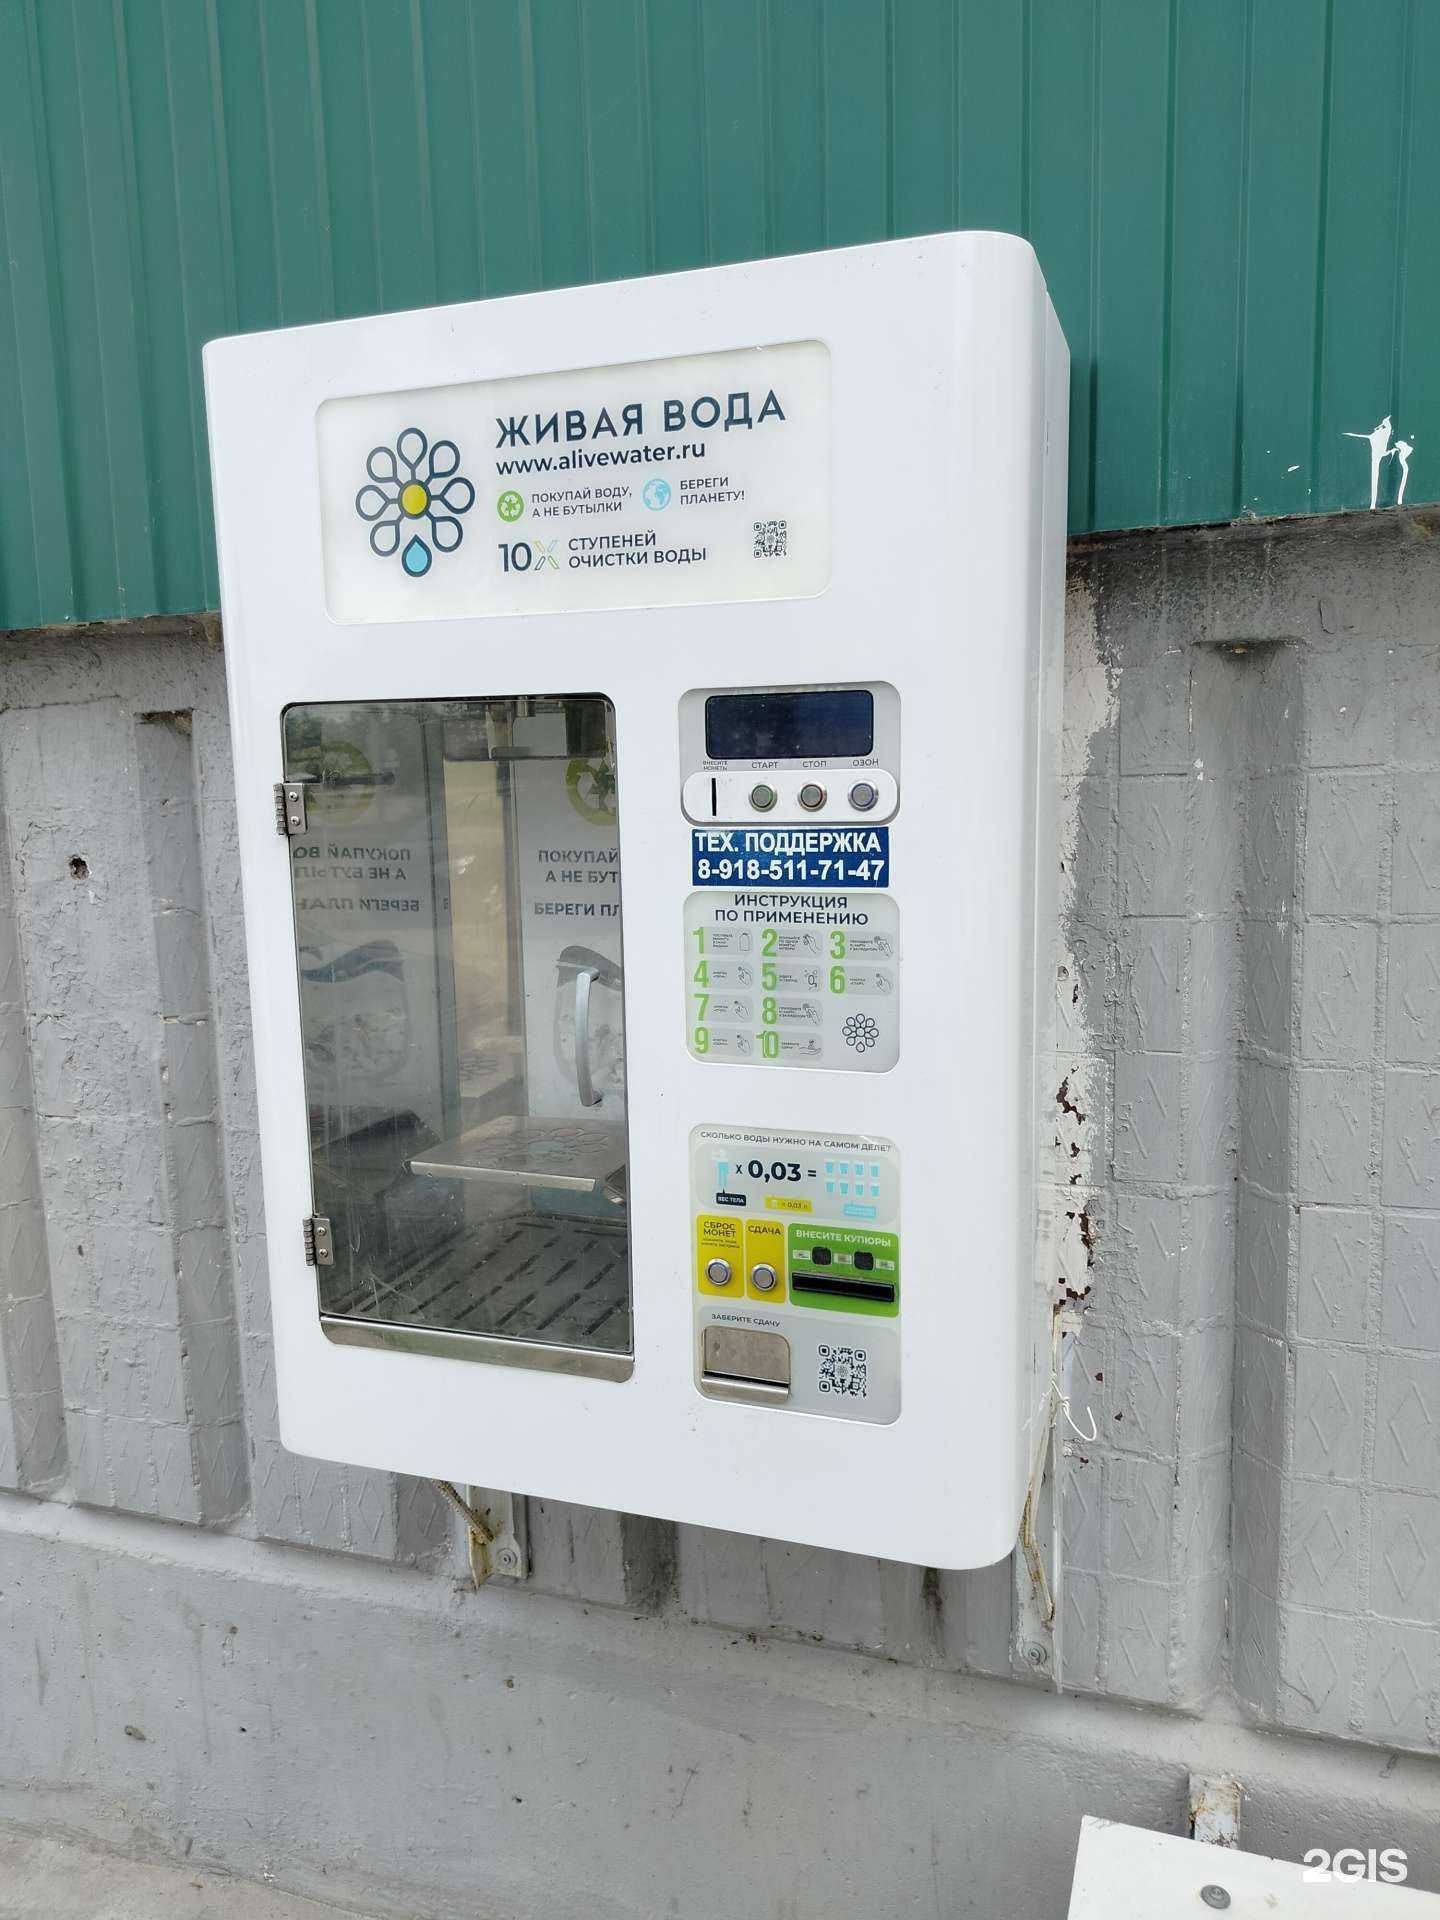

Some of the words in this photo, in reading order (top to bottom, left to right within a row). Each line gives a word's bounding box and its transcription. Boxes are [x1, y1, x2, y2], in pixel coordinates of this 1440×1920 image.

[495, 403, 644, 449] ЖИВАЯ
[664, 389, 786, 432] ВОДА
[496, 441, 706, 476] www.alivewater.ru
[680, 476, 729, 491] БЕРЕГИ
[531, 487, 591, 504] ПОКУПАЙ
[594, 485, 633, 501] ВОДУ,
[680, 490, 745, 505] ПЛАНЕТУ!
[532, 507, 541, 518] А
[544, 506, 560, 517] НЕ
[562, 501, 622, 516] БУТЫЛКИ
[568, 530, 657, 552] СТУПЕНЕЙ
[568, 550, 648, 569] ОЧИСТКИ
[654, 547, 707, 564] ВОДЫ
[751, 761, 779, 769] СТАРТ
[802, 760, 827, 768] СТОП
[852, 759, 879, 767] ОЗОН
[695, 832, 739, 852] ТЕХ.
[745, 832, 882, 856] ПОДДЕРЖКА
[545, 870, 557, 882] А
[561, 870, 583, 883] НЕ
[697, 859, 885, 880] 8-918-511-71-47
[534, 902, 595, 916] БЕРЕГИ
[734, 894, 848, 910] ИНСТРУКЦИЯ
[715, 910, 738, 922] ПО
[743, 910, 869, 926] ПРИМЕНЕНИЮ
[692, 926, 705, 954] 1
[761, 928, 778, 957] 2
[830, 930, 846, 960] 3
[693, 960, 710, 988] 4
[761, 963, 778, 991] 5
[829, 965, 846, 994] 6
[693, 993, 709, 1021] 7
[762, 996, 777, 1025] 8
[694, 1027, 709, 1054] 9
[756, 1030, 779, 1058] 10
[700, 1131, 742, 1141] СКОЛЬКО
[744, 1134, 770, 1143] ВОДЫ
[772, 1137, 806, 1146] НУЖНО
[823, 1141, 859, 1150] САМОМ
[748, 1160, 802, 1183] 0,03
[703, 1221, 735, 1231] СБРОС
[703, 1228, 736, 1238] МОНЕТ
[748, 1225, 782, 1235] СДАЧА
[795, 1229, 842, 1241] ВНЕСИТЕ
[844, 1234, 891, 1248] КУПЮРЫ
[711, 1313, 752, 1324] ЗАБЕРИТЕ
[753, 1318, 780, 1328] СДАЧУ
